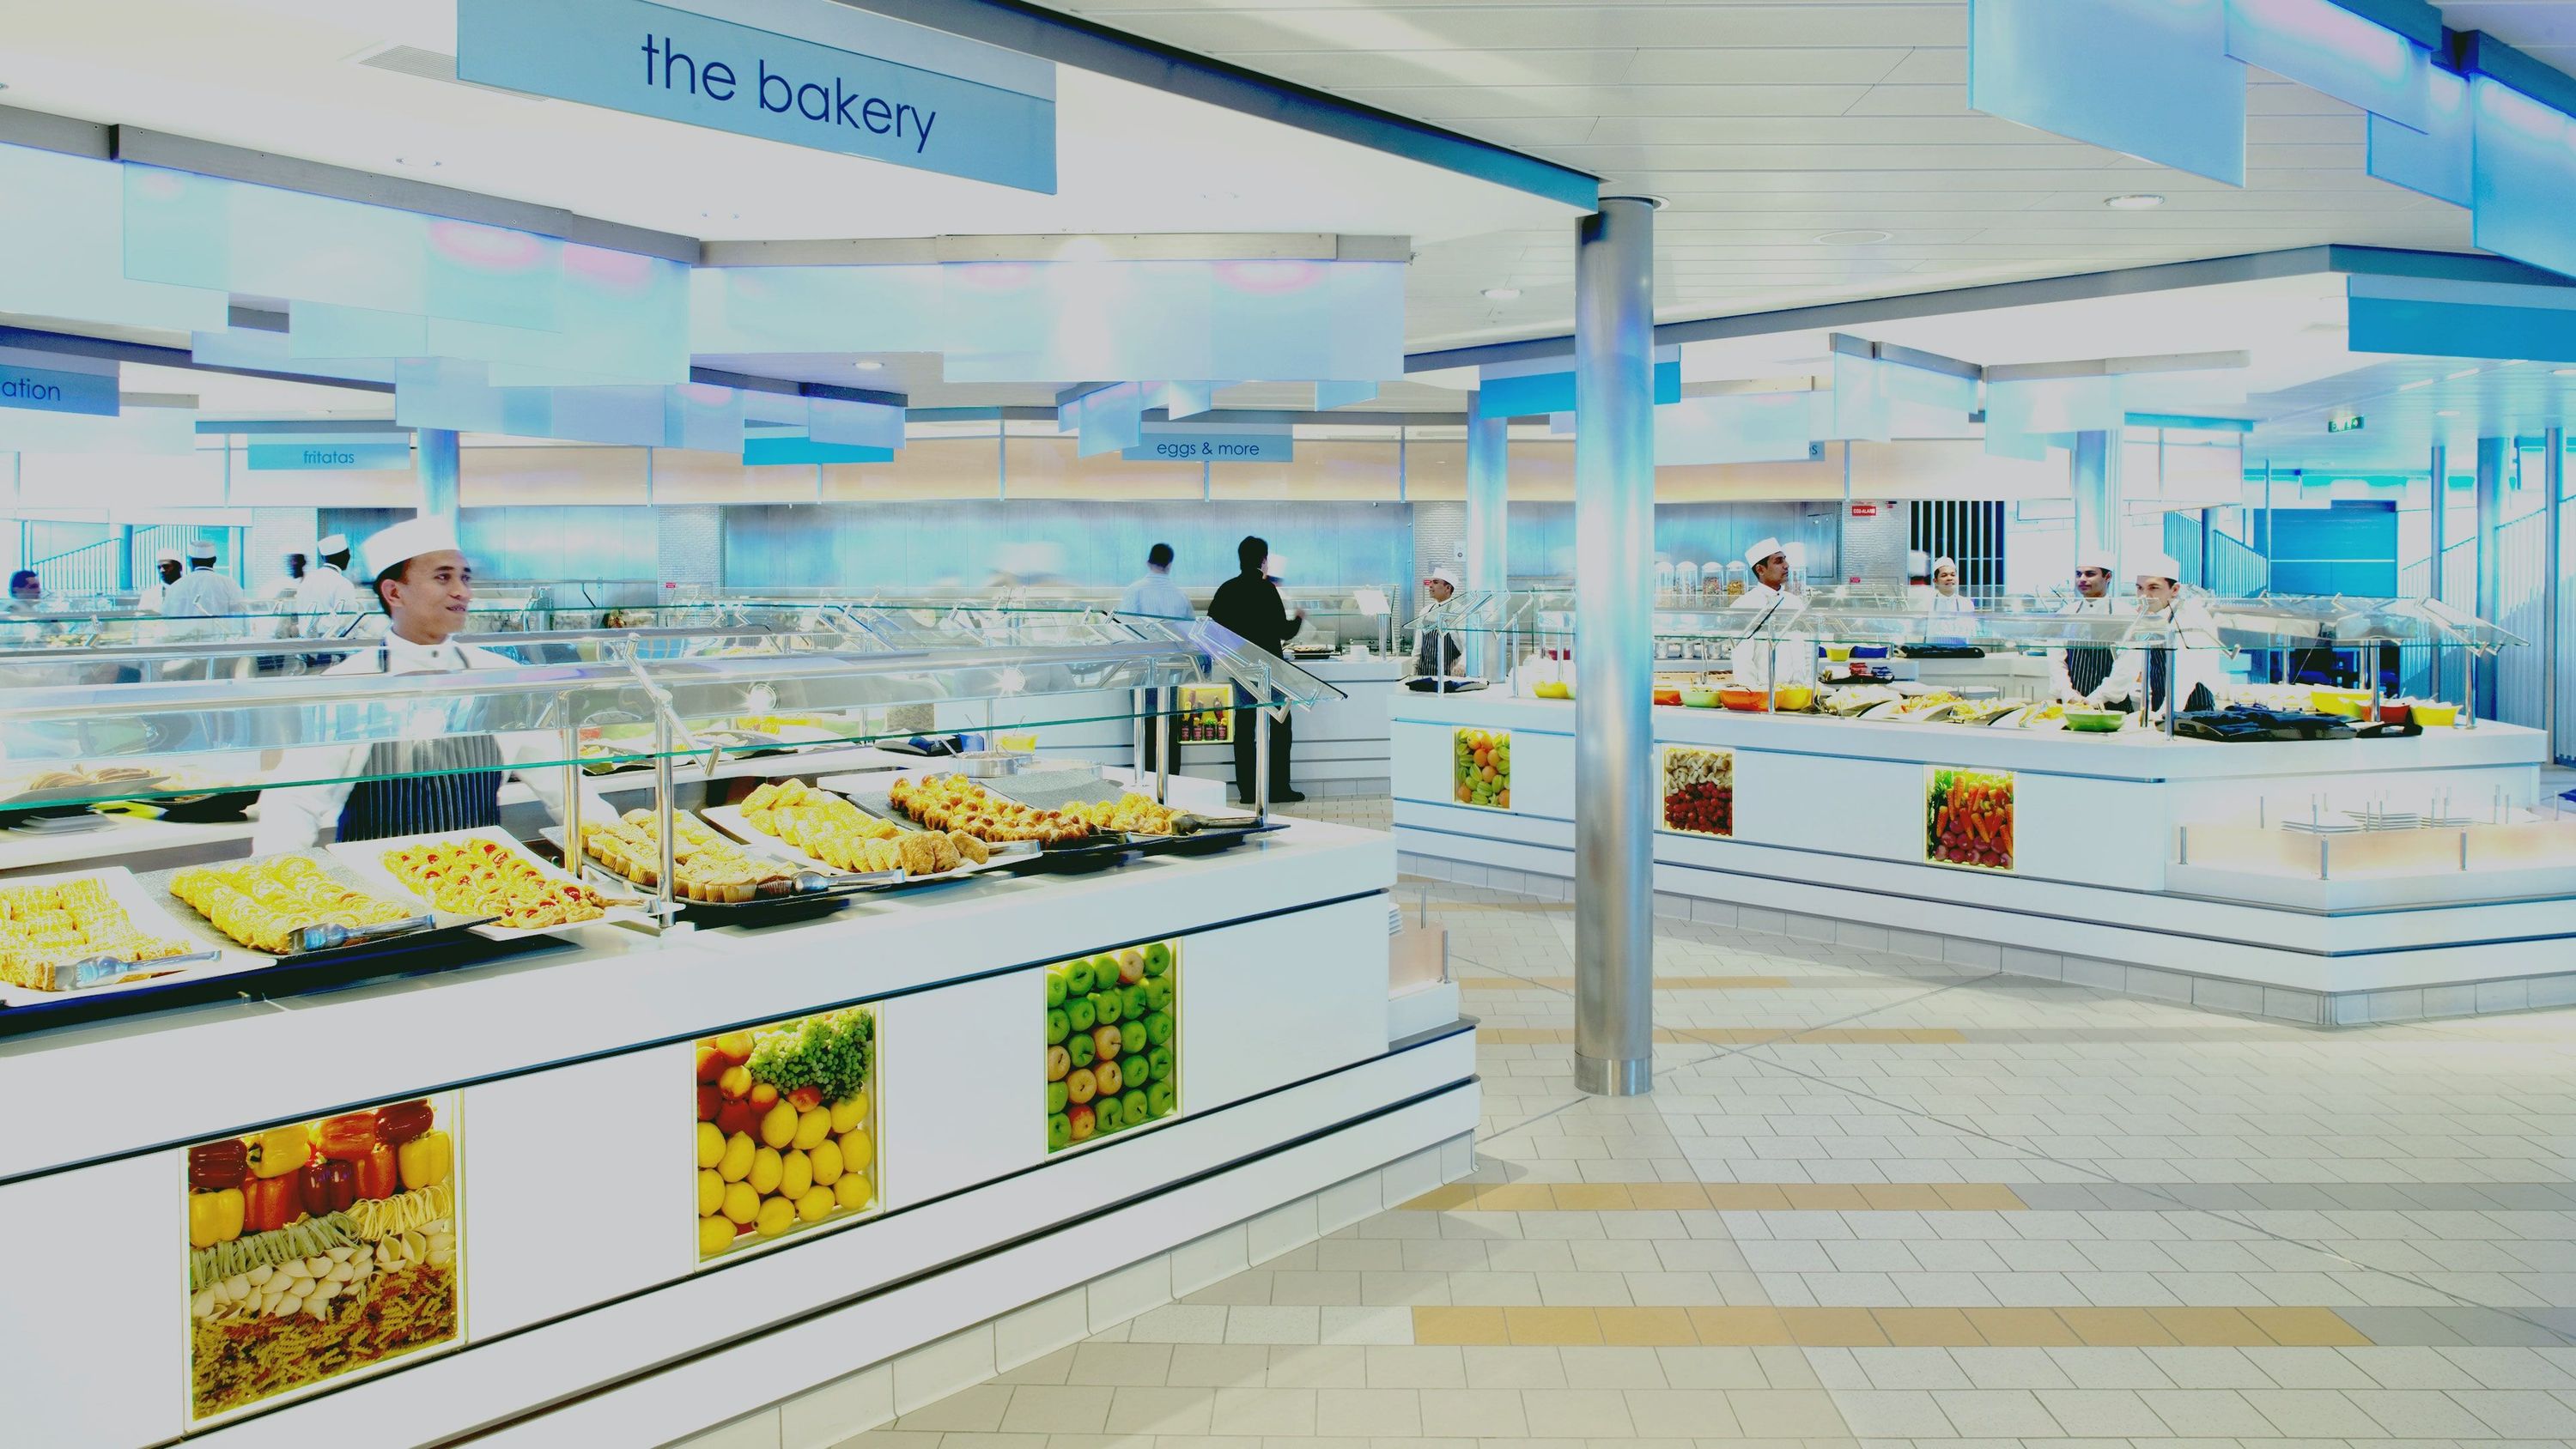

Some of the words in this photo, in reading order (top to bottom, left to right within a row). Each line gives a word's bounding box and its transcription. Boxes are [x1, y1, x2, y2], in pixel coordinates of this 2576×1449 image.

[641, 33, 736, 101] the
[759, 59, 936, 154] bakery
[303, 450, 355, 464] fritatas
[1157, 443, 1196, 458] eggs
[1201, 441, 1213, 455] &
[1218, 445, 1260, 455] more
